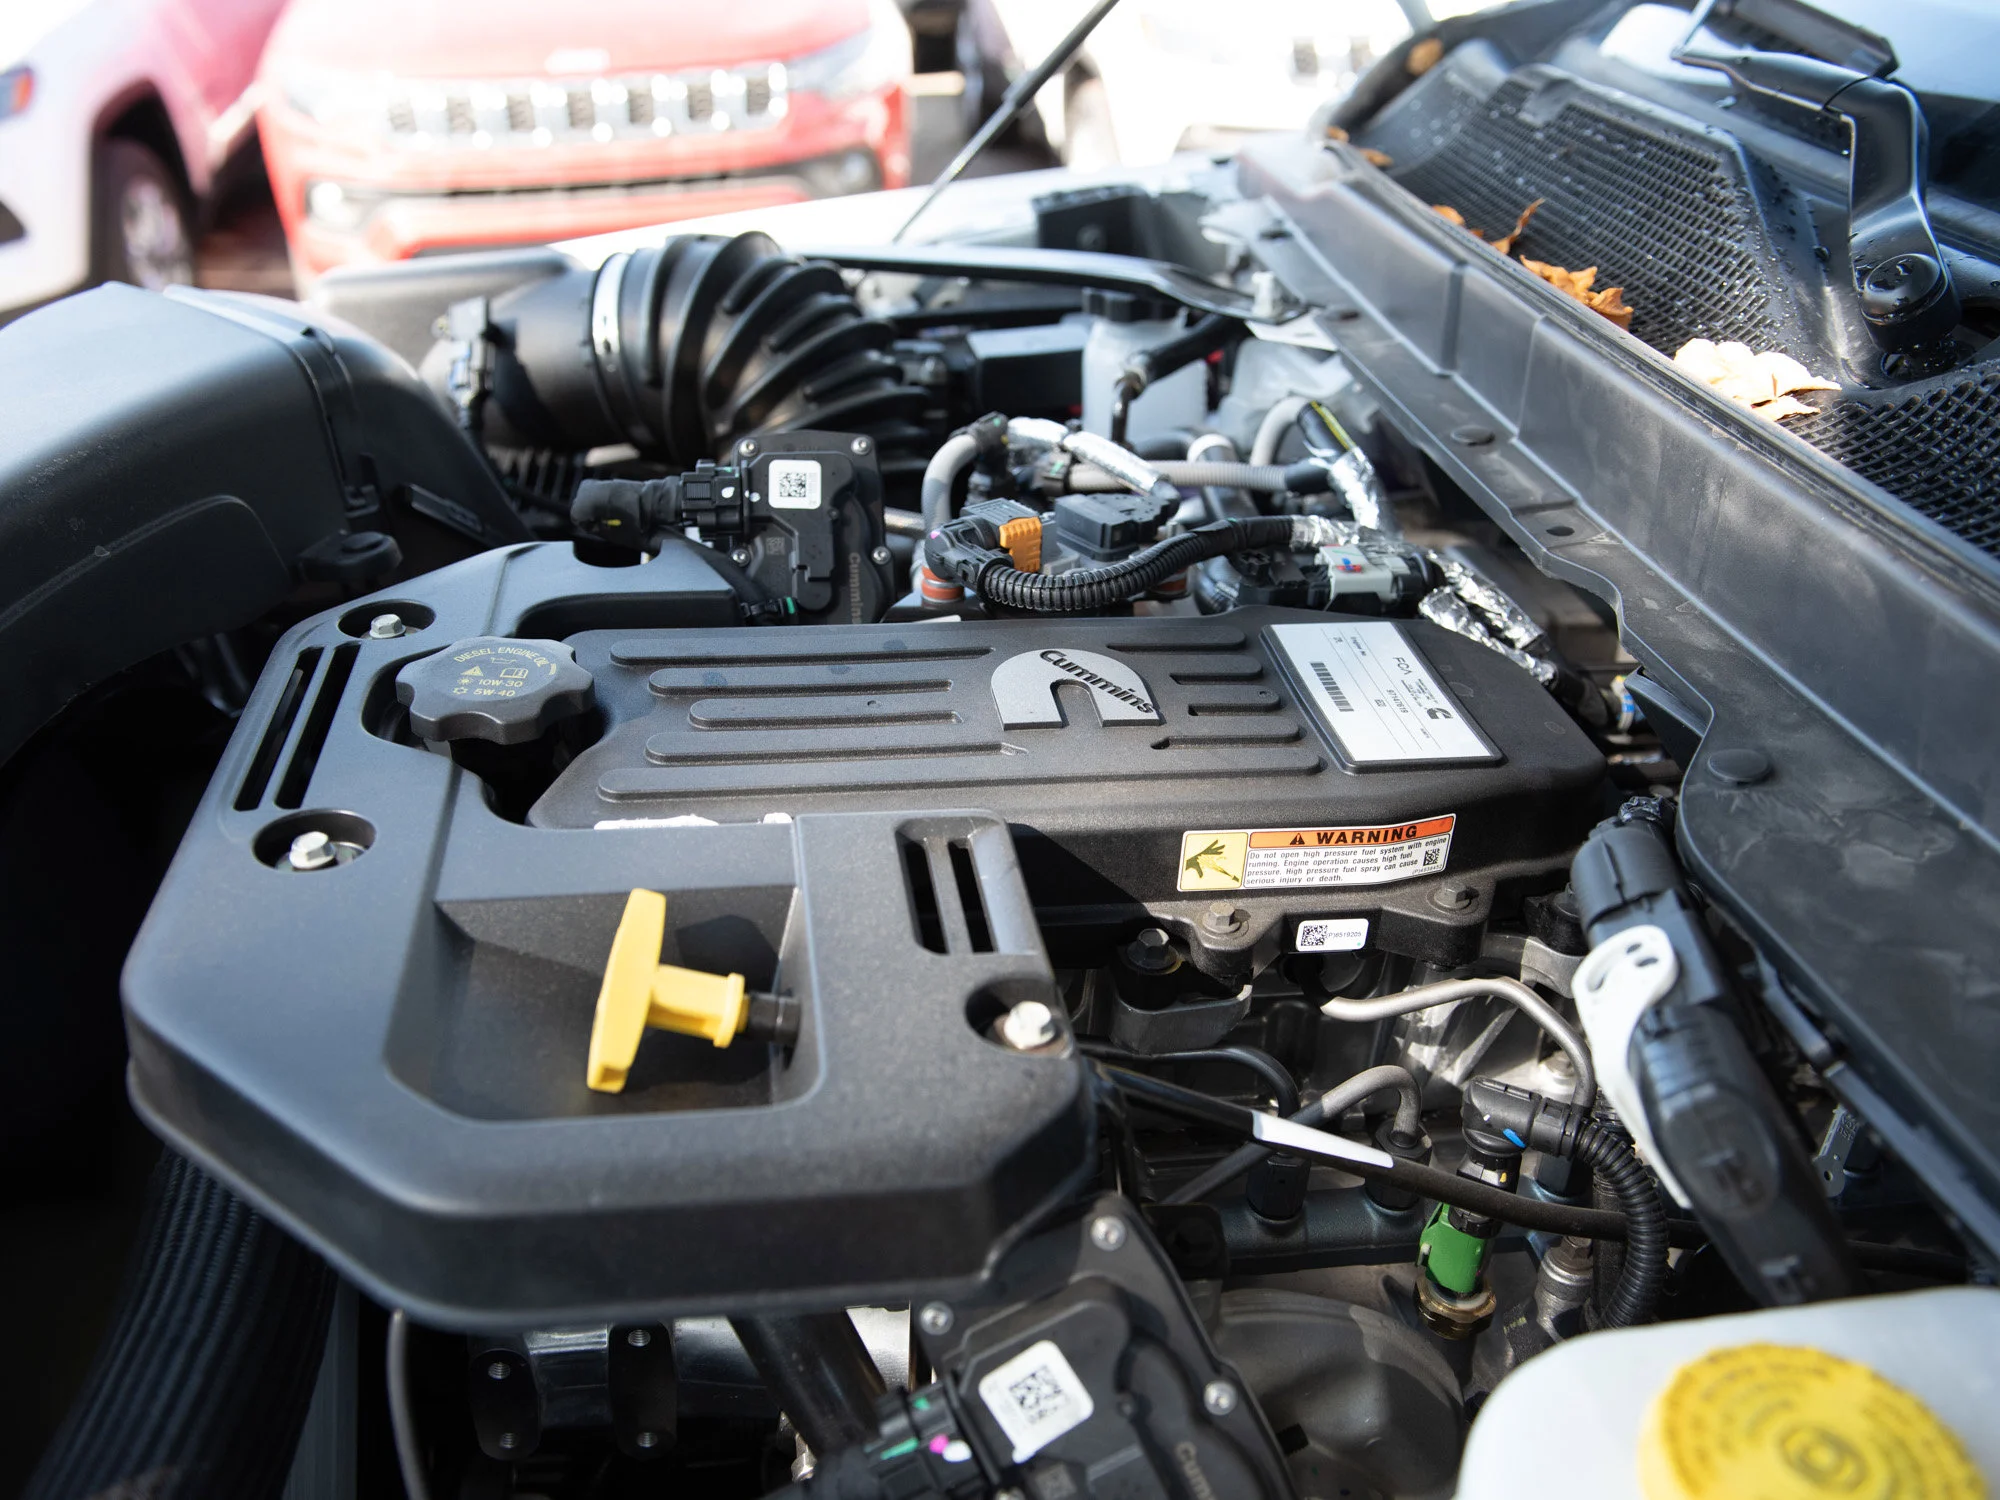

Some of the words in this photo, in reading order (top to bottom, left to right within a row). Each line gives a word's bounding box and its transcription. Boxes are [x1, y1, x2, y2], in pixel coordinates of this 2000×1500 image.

[454, 648, 495, 662] DIESEL
[498, 647, 540, 659] ENGINE
[533, 657, 550, 667] OIL
[479, 679, 523, 687] 10W-30
[1039, 649, 1154, 714] Cummins
[473, 688, 516, 697] 5W-40
[1316, 825, 1417, 844] WARNING
[1249, 852, 1260, 860] Do
[1264, 851, 1277, 859] not
[1280, 851, 1300, 860] open
[1303, 850, 1321, 859] high
[1324, 849, 1358, 858] pressure
[1361, 848, 1377, 856] fuel
[1380, 845, 1405, 856] system
[1407, 841, 1423, 850] with
[1424, 837, 1447, 847] engine
[1247, 869, 1282, 877] pressure.
[1285, 868, 1303, 876] High
[1306, 867, 1340, 875] pressure
[1360, 865, 1381, 873] spray
[1383, 863, 1397, 871] can
[1399, 859, 1419, 868] cause
[1248, 861, 1280, 869] running.
[1283, 859, 1310, 868] Engine
[1312, 857, 1349, 867] operation
[1352, 857, 1379, 865] causes
[1382, 855, 1397, 864] high
[1400, 850, 1413, 860] fuel
[1279, 876, 1303, 884] injury
[1175, 1441, 1216, 1500] Cum
